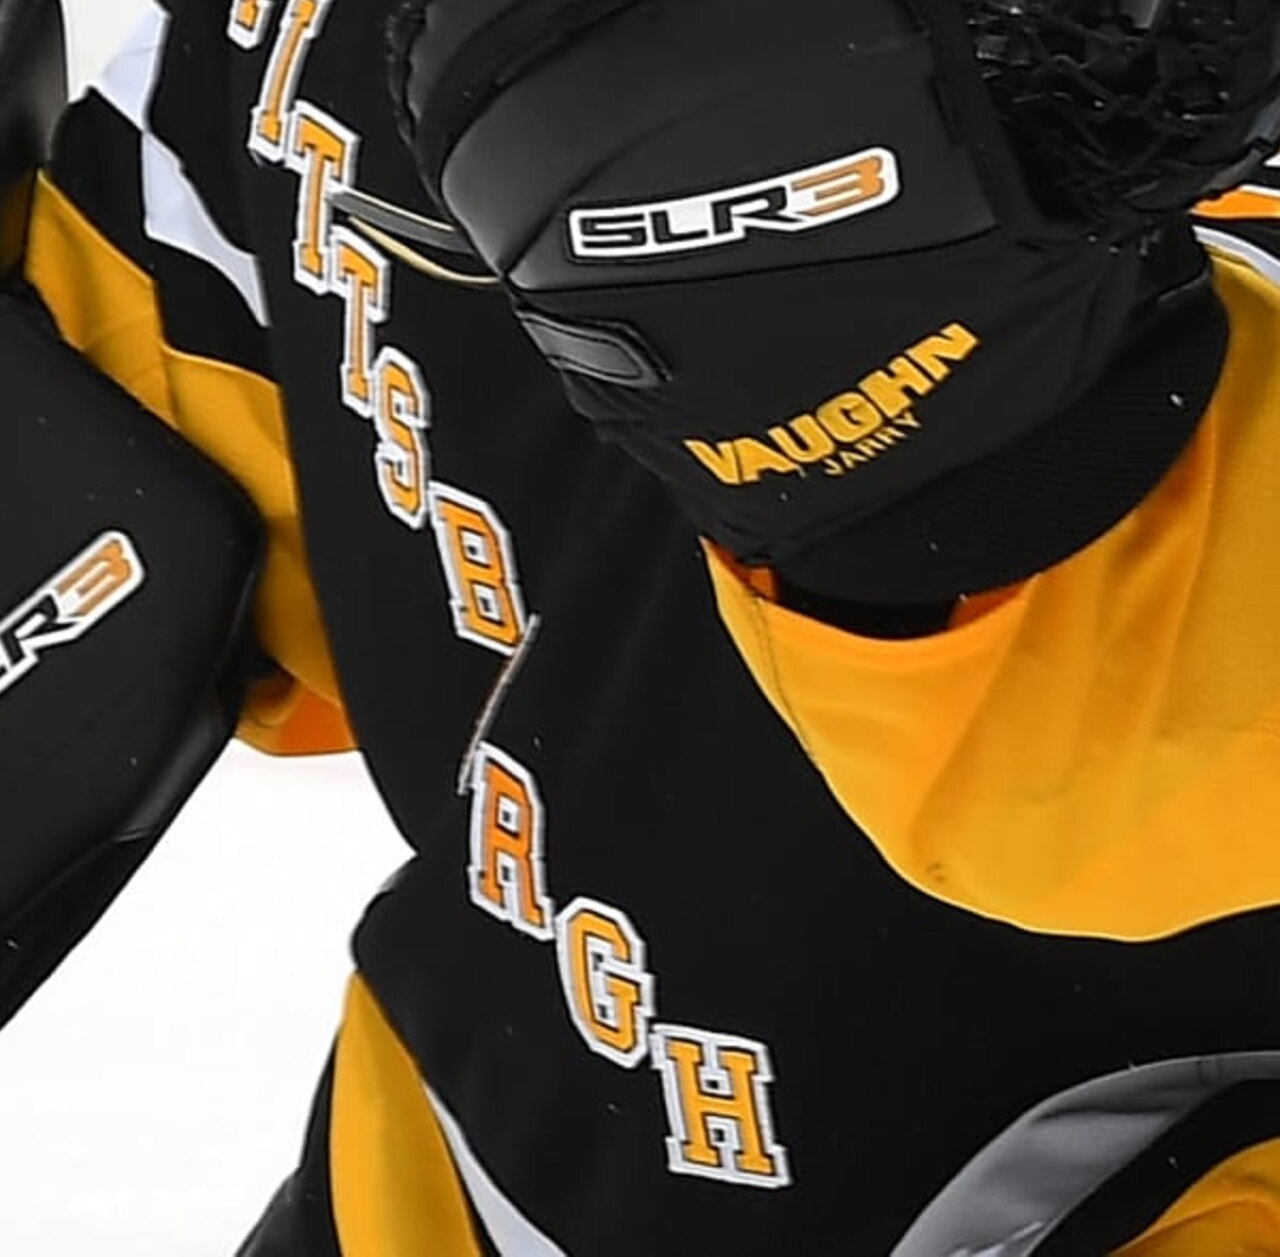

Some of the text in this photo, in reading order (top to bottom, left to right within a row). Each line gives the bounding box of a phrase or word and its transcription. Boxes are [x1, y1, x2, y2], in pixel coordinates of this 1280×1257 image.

[572, 150, 896, 256] SLR3
[683, 322, 980, 486] VAUGHN
[823, 411, 921, 476] JARRY
